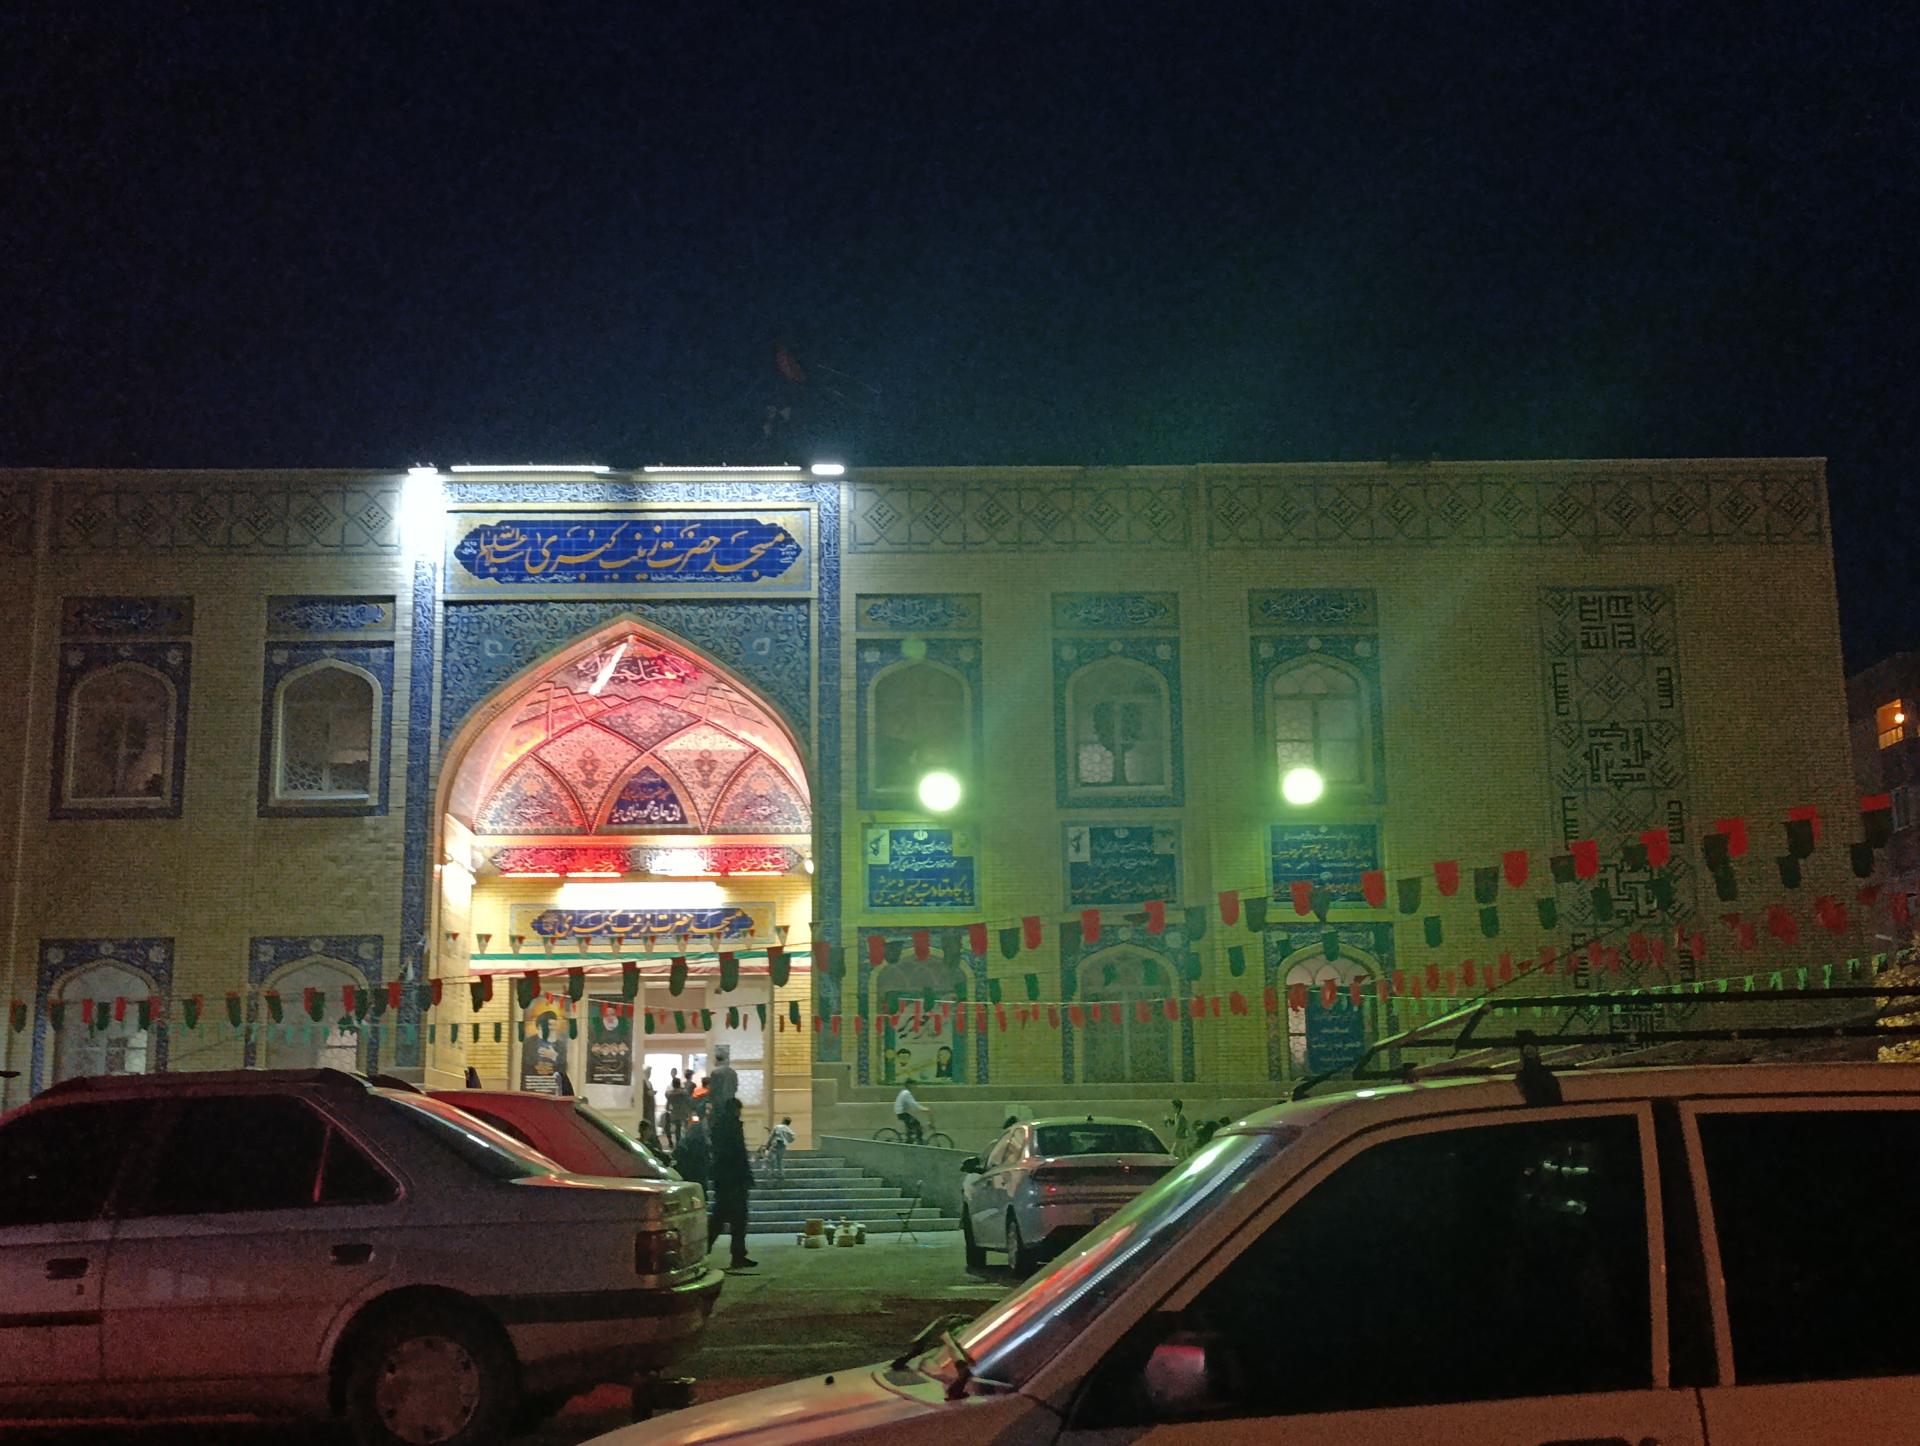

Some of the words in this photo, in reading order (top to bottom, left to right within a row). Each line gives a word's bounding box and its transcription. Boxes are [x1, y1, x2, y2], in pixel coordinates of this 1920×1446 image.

[525, 521, 630, 580] کبری
[599, 525, 662, 580] زینب
[647, 524, 721, 573] حضرت
[703, 531, 785, 578] مسجد
